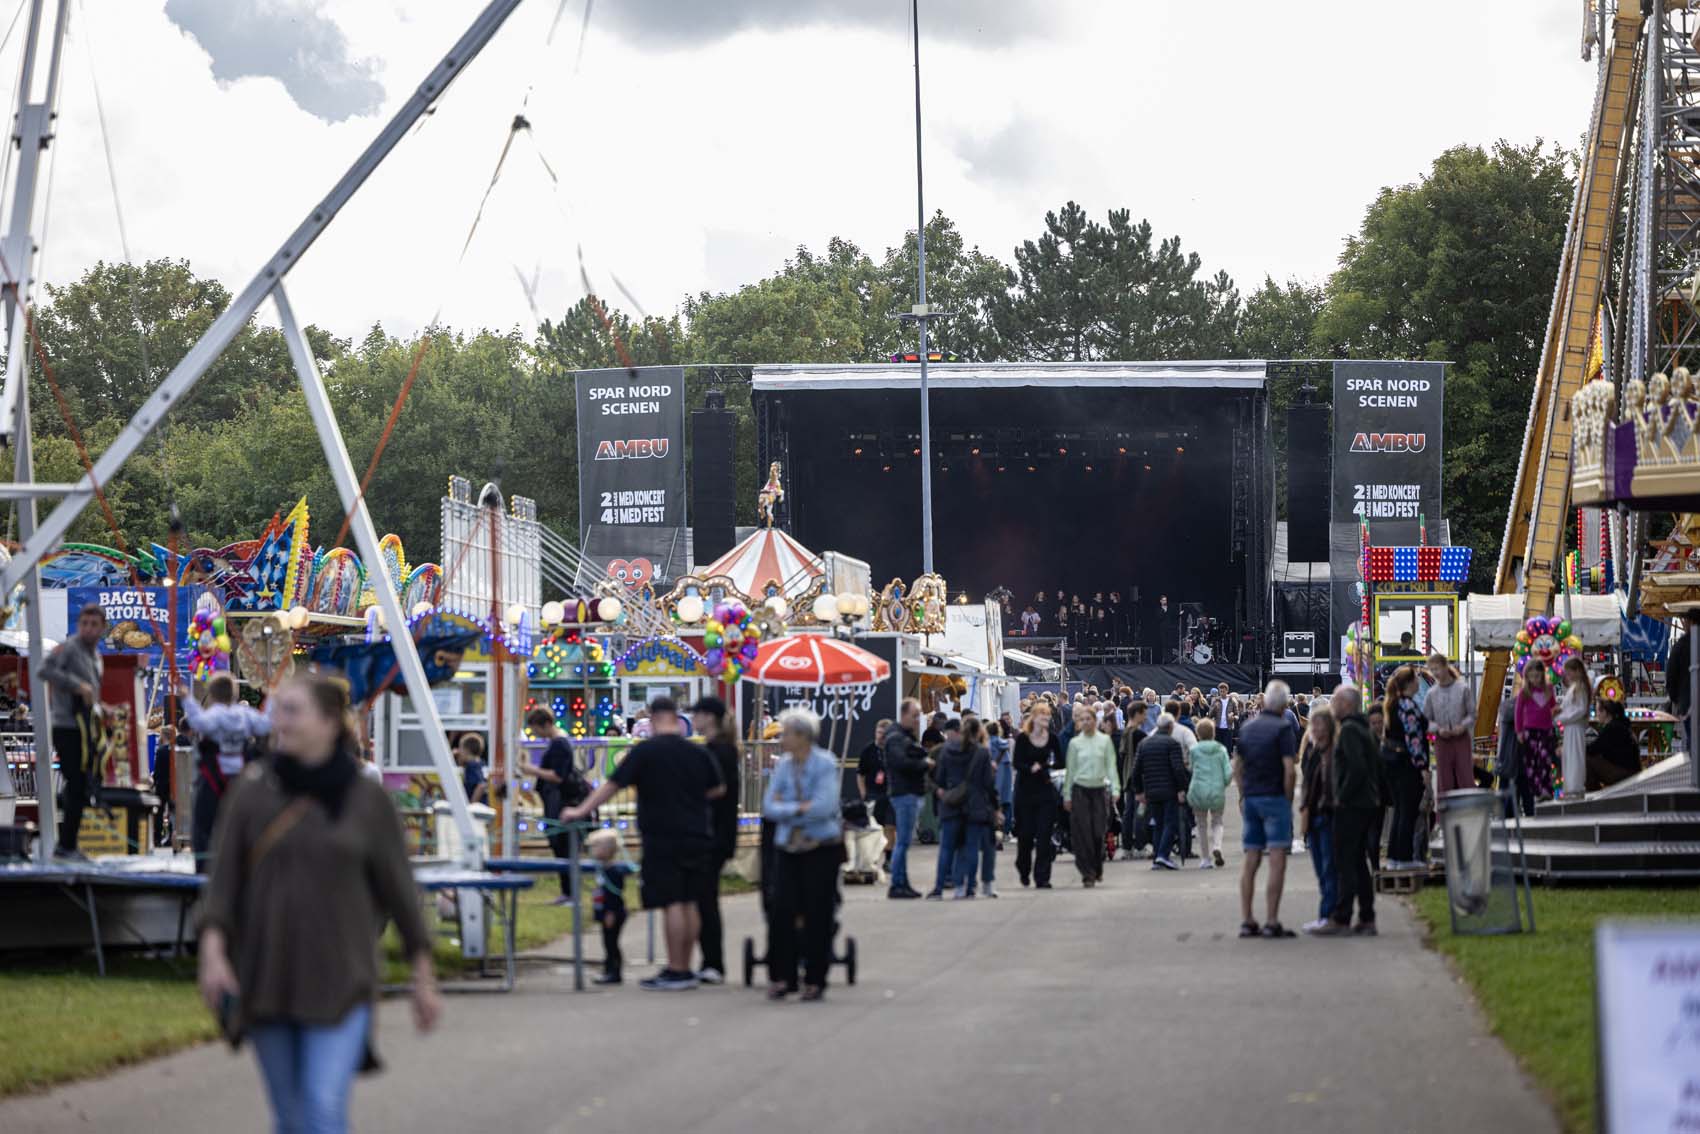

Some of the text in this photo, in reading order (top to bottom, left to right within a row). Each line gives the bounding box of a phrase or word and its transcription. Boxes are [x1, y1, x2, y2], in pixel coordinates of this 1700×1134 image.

[589, 385, 672, 400] SPAR NORD
[1346, 379, 1431, 392] SPAR NORD
[601, 402, 660, 415] SCENEN
[1359, 395, 1418, 408] SCENEN
[594, 438, 669, 461] AMBU
[1349, 432, 1426, 453] AMBU
[600, 491, 613, 507] 2
[619, 491, 634, 507] MED
[634, 489, 666, 506] KONCERT
[1353, 484, 1366, 500] 2
[1372, 484, 1388, 500] MED
[1388, 484, 1421, 500] KONCERT
[600, 508, 614, 525] 4
[619, 507, 642, 524] MED
[642, 506, 665, 523] FEST
[1352, 501, 1366, 517] 4
[1372, 501, 1395, 518] MED
[1395, 501, 1420, 518] FEST
[99, 591, 156, 606] BAGTE
[105, 606, 170, 624] RTOFLER
